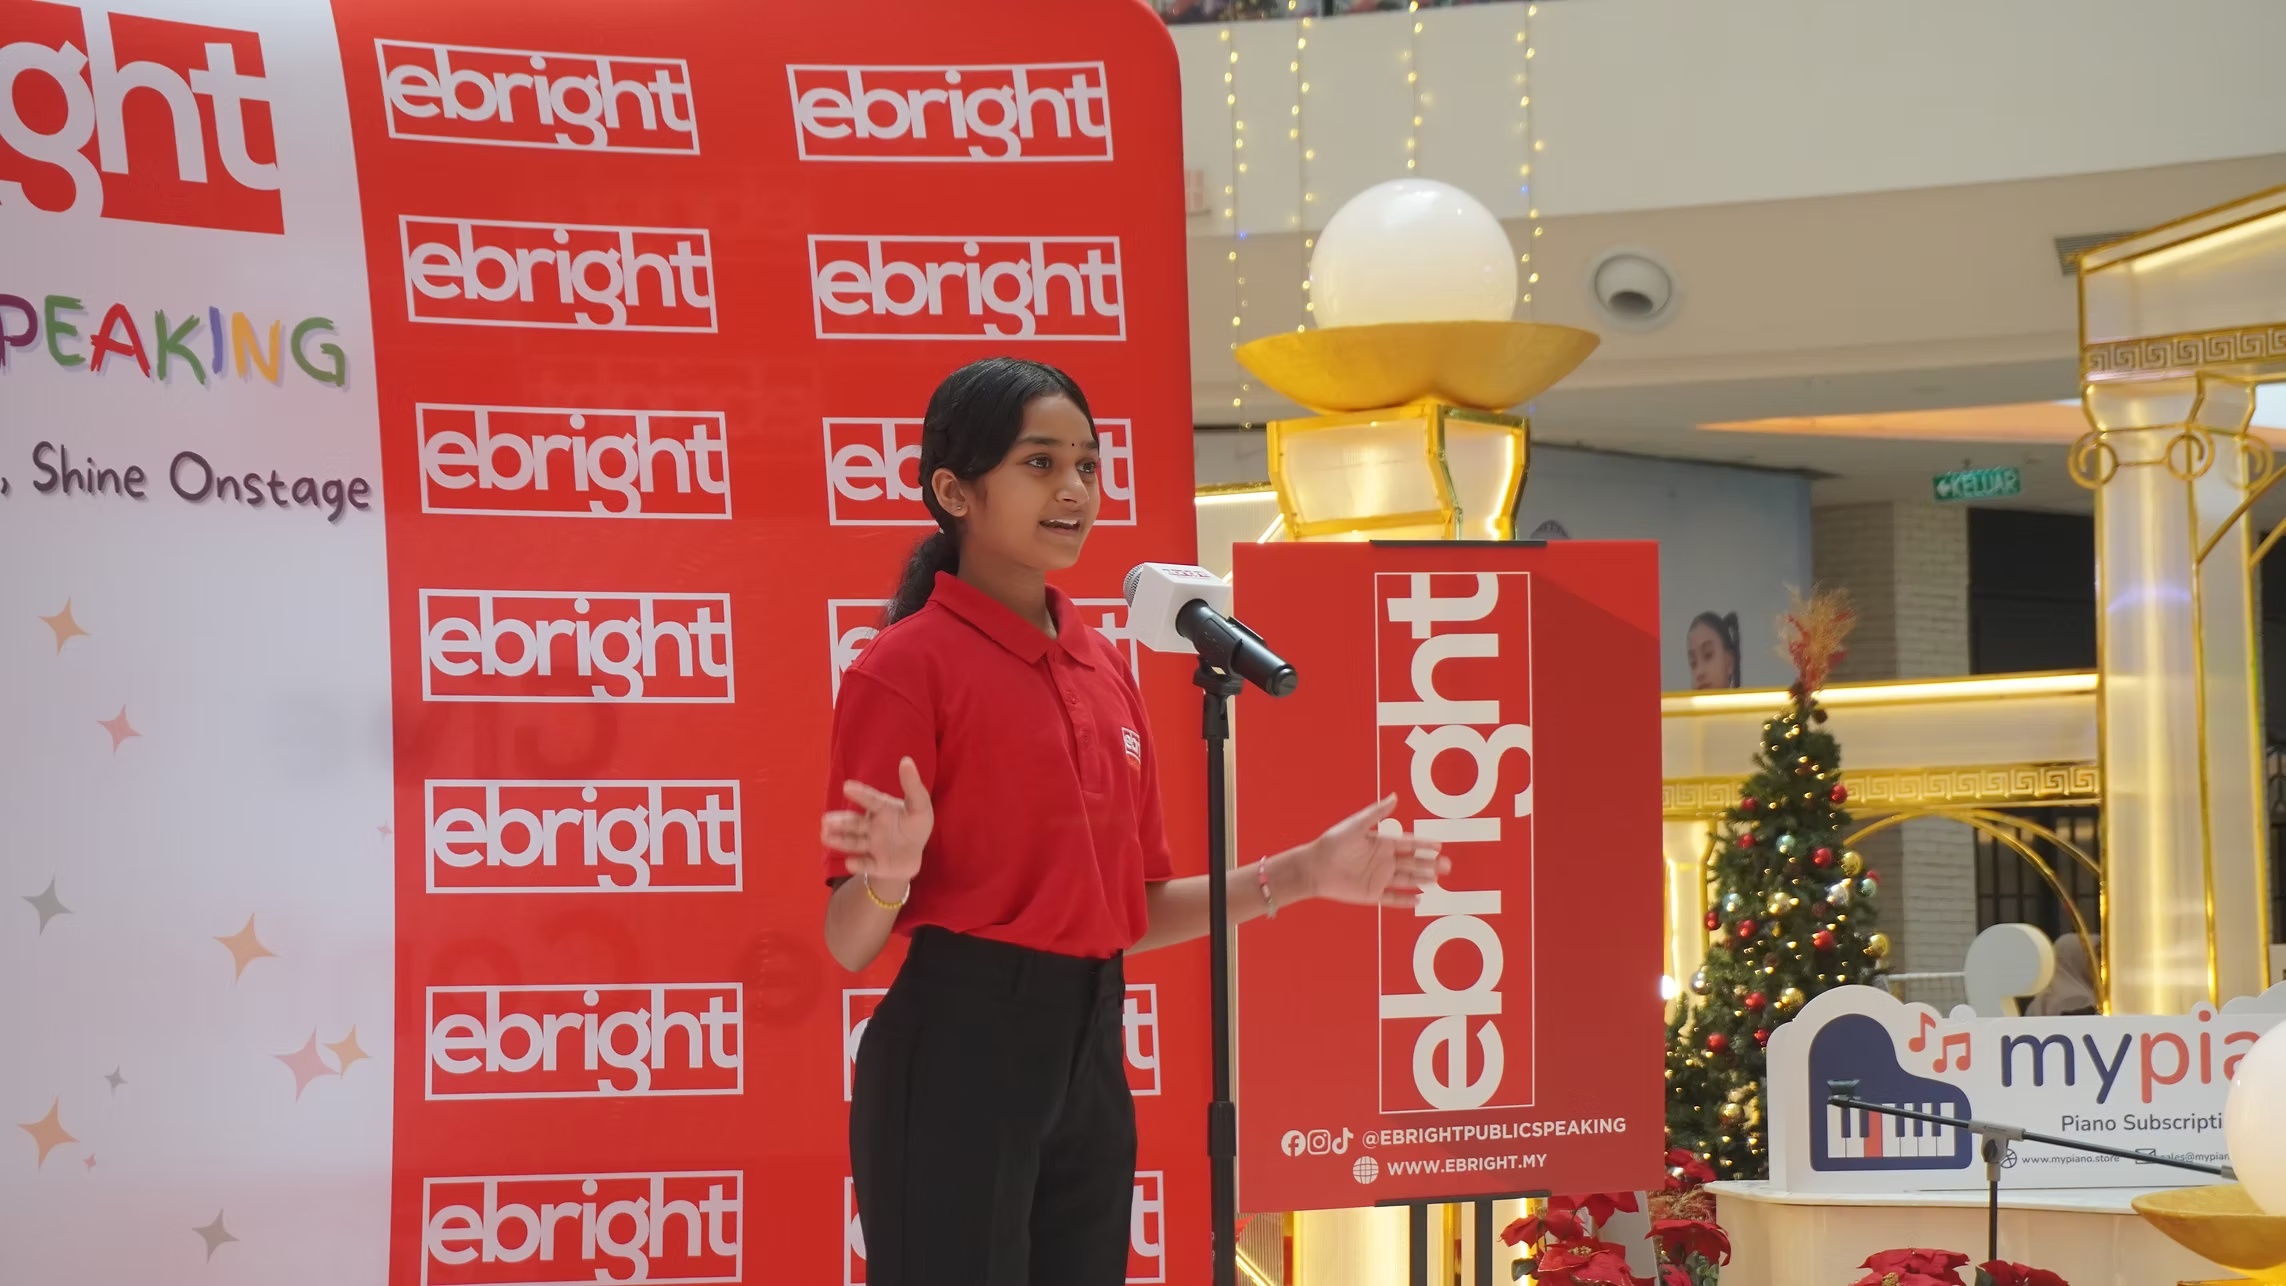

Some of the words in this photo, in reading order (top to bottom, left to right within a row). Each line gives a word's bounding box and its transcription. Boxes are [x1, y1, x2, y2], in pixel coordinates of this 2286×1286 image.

[386, 46, 694, 150] ebright
[798, 66, 1105, 158] ebright
[407, 220, 712, 328] ebright
[817, 239, 1119, 338] ebright
[32, 441, 146, 500] Shine
[169, 451, 371, 523] Onstage
[424, 409, 726, 514] ebright
[427, 593, 728, 699] ebright
[431, 786, 738, 888] ebright
[1378, 573, 1532, 1111] ebright
[431, 988, 740, 1092] ebright
[1362, 1117, 1627, 1149] @EBRIGHTPUBLICSPEAKING
[1387, 1154, 1548, 1176] WWW.EBRIGHT.MY
[2021, 1154, 2121, 1165] www.mypiano.store
[2061, 1115, 2117, 1132] Piano
[2123, 1113, 2223, 1133] Subscripti
[427, 1178, 738, 1283] ebright
